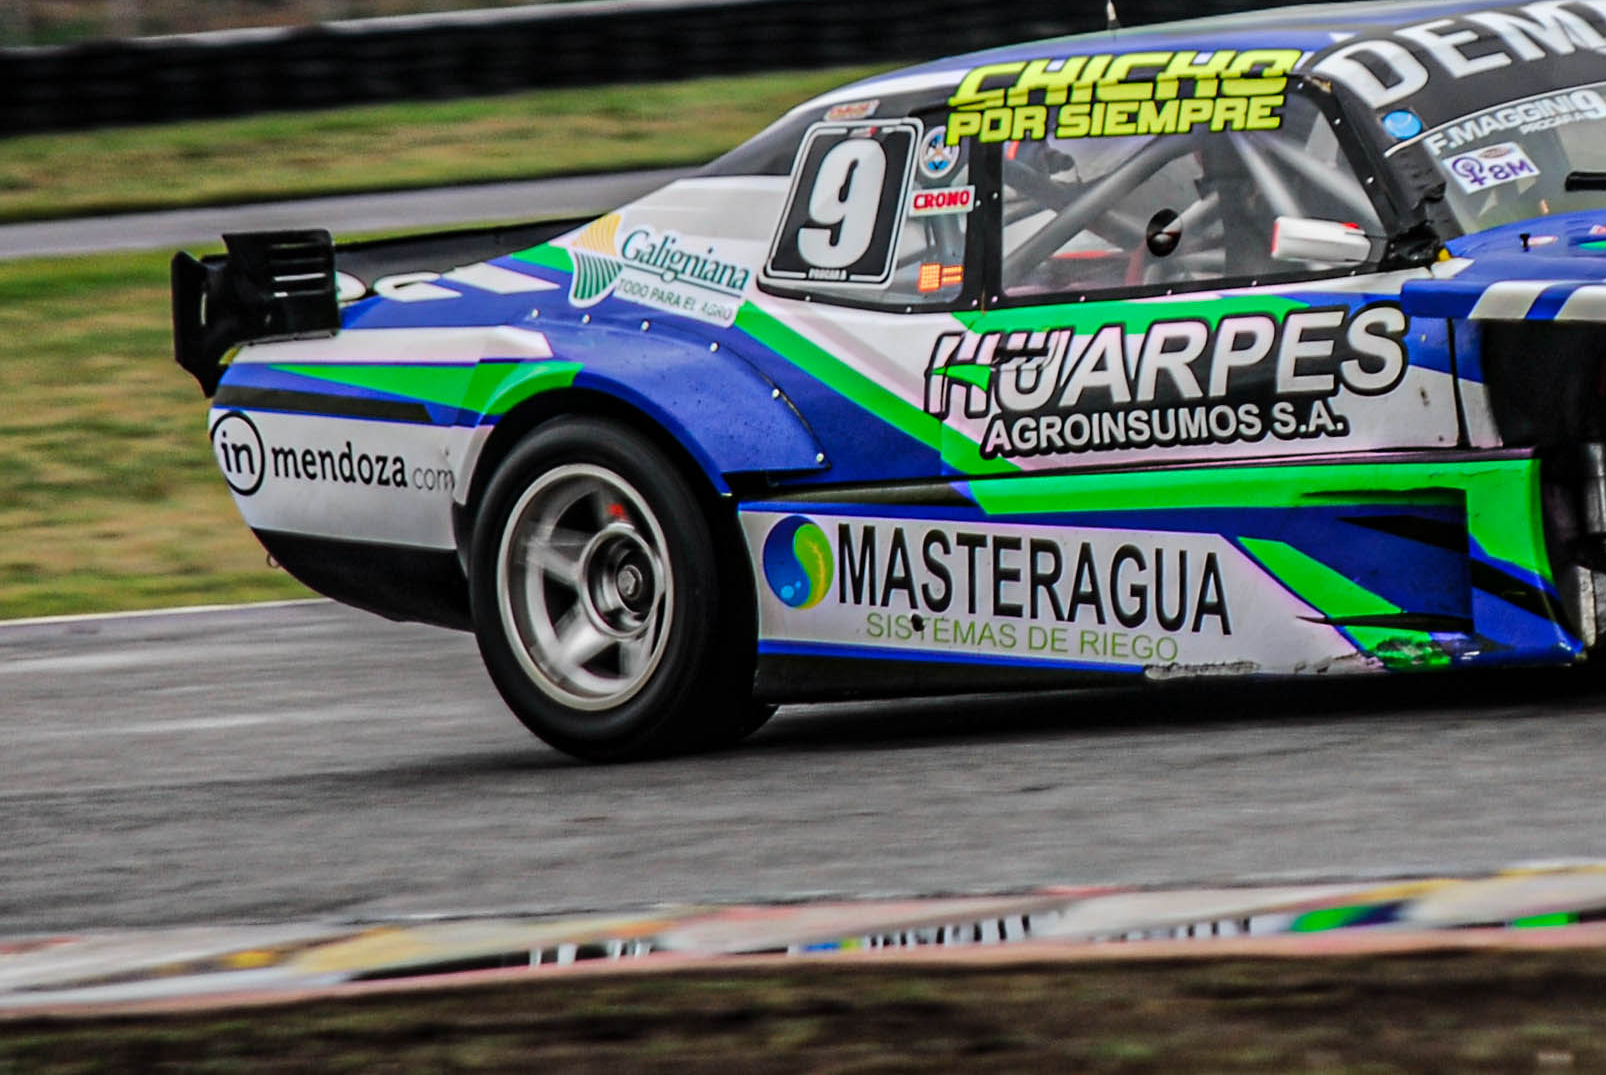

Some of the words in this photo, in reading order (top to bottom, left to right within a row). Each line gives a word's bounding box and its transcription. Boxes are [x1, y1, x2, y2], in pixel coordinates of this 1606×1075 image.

[947, 49, 1302, 110] CHICHO
[946, 105, 1048, 147] POR
[1055, 95, 1285, 139] SIEMPRE
[1423, 93, 1574, 157] F.MAGGINI
[1488, 158, 1535, 181] 8M
[797, 138, 887, 269] 9
[912, 190, 970, 211] CRONO
[621, 229, 750, 291] Galigniana
[618, 277, 650, 298] TODO
[649, 285, 681, 309] PARA
[682, 297, 697, 312] EL
[927, 306, 1408, 418] HUARPES
[984, 405, 1260, 456] AGROINSUMOS
[1273, 399, 1345, 438] S.A.
[220, 430, 256, 475] in
[271, 441, 408, 488] mendoza
[837, 522, 1232, 635] MASTERAGUA
[866, 611, 1018, 649] SISTEMAS
[1027, 624, 1071, 654] DE
[1079, 630, 1179, 663] RIEGO
